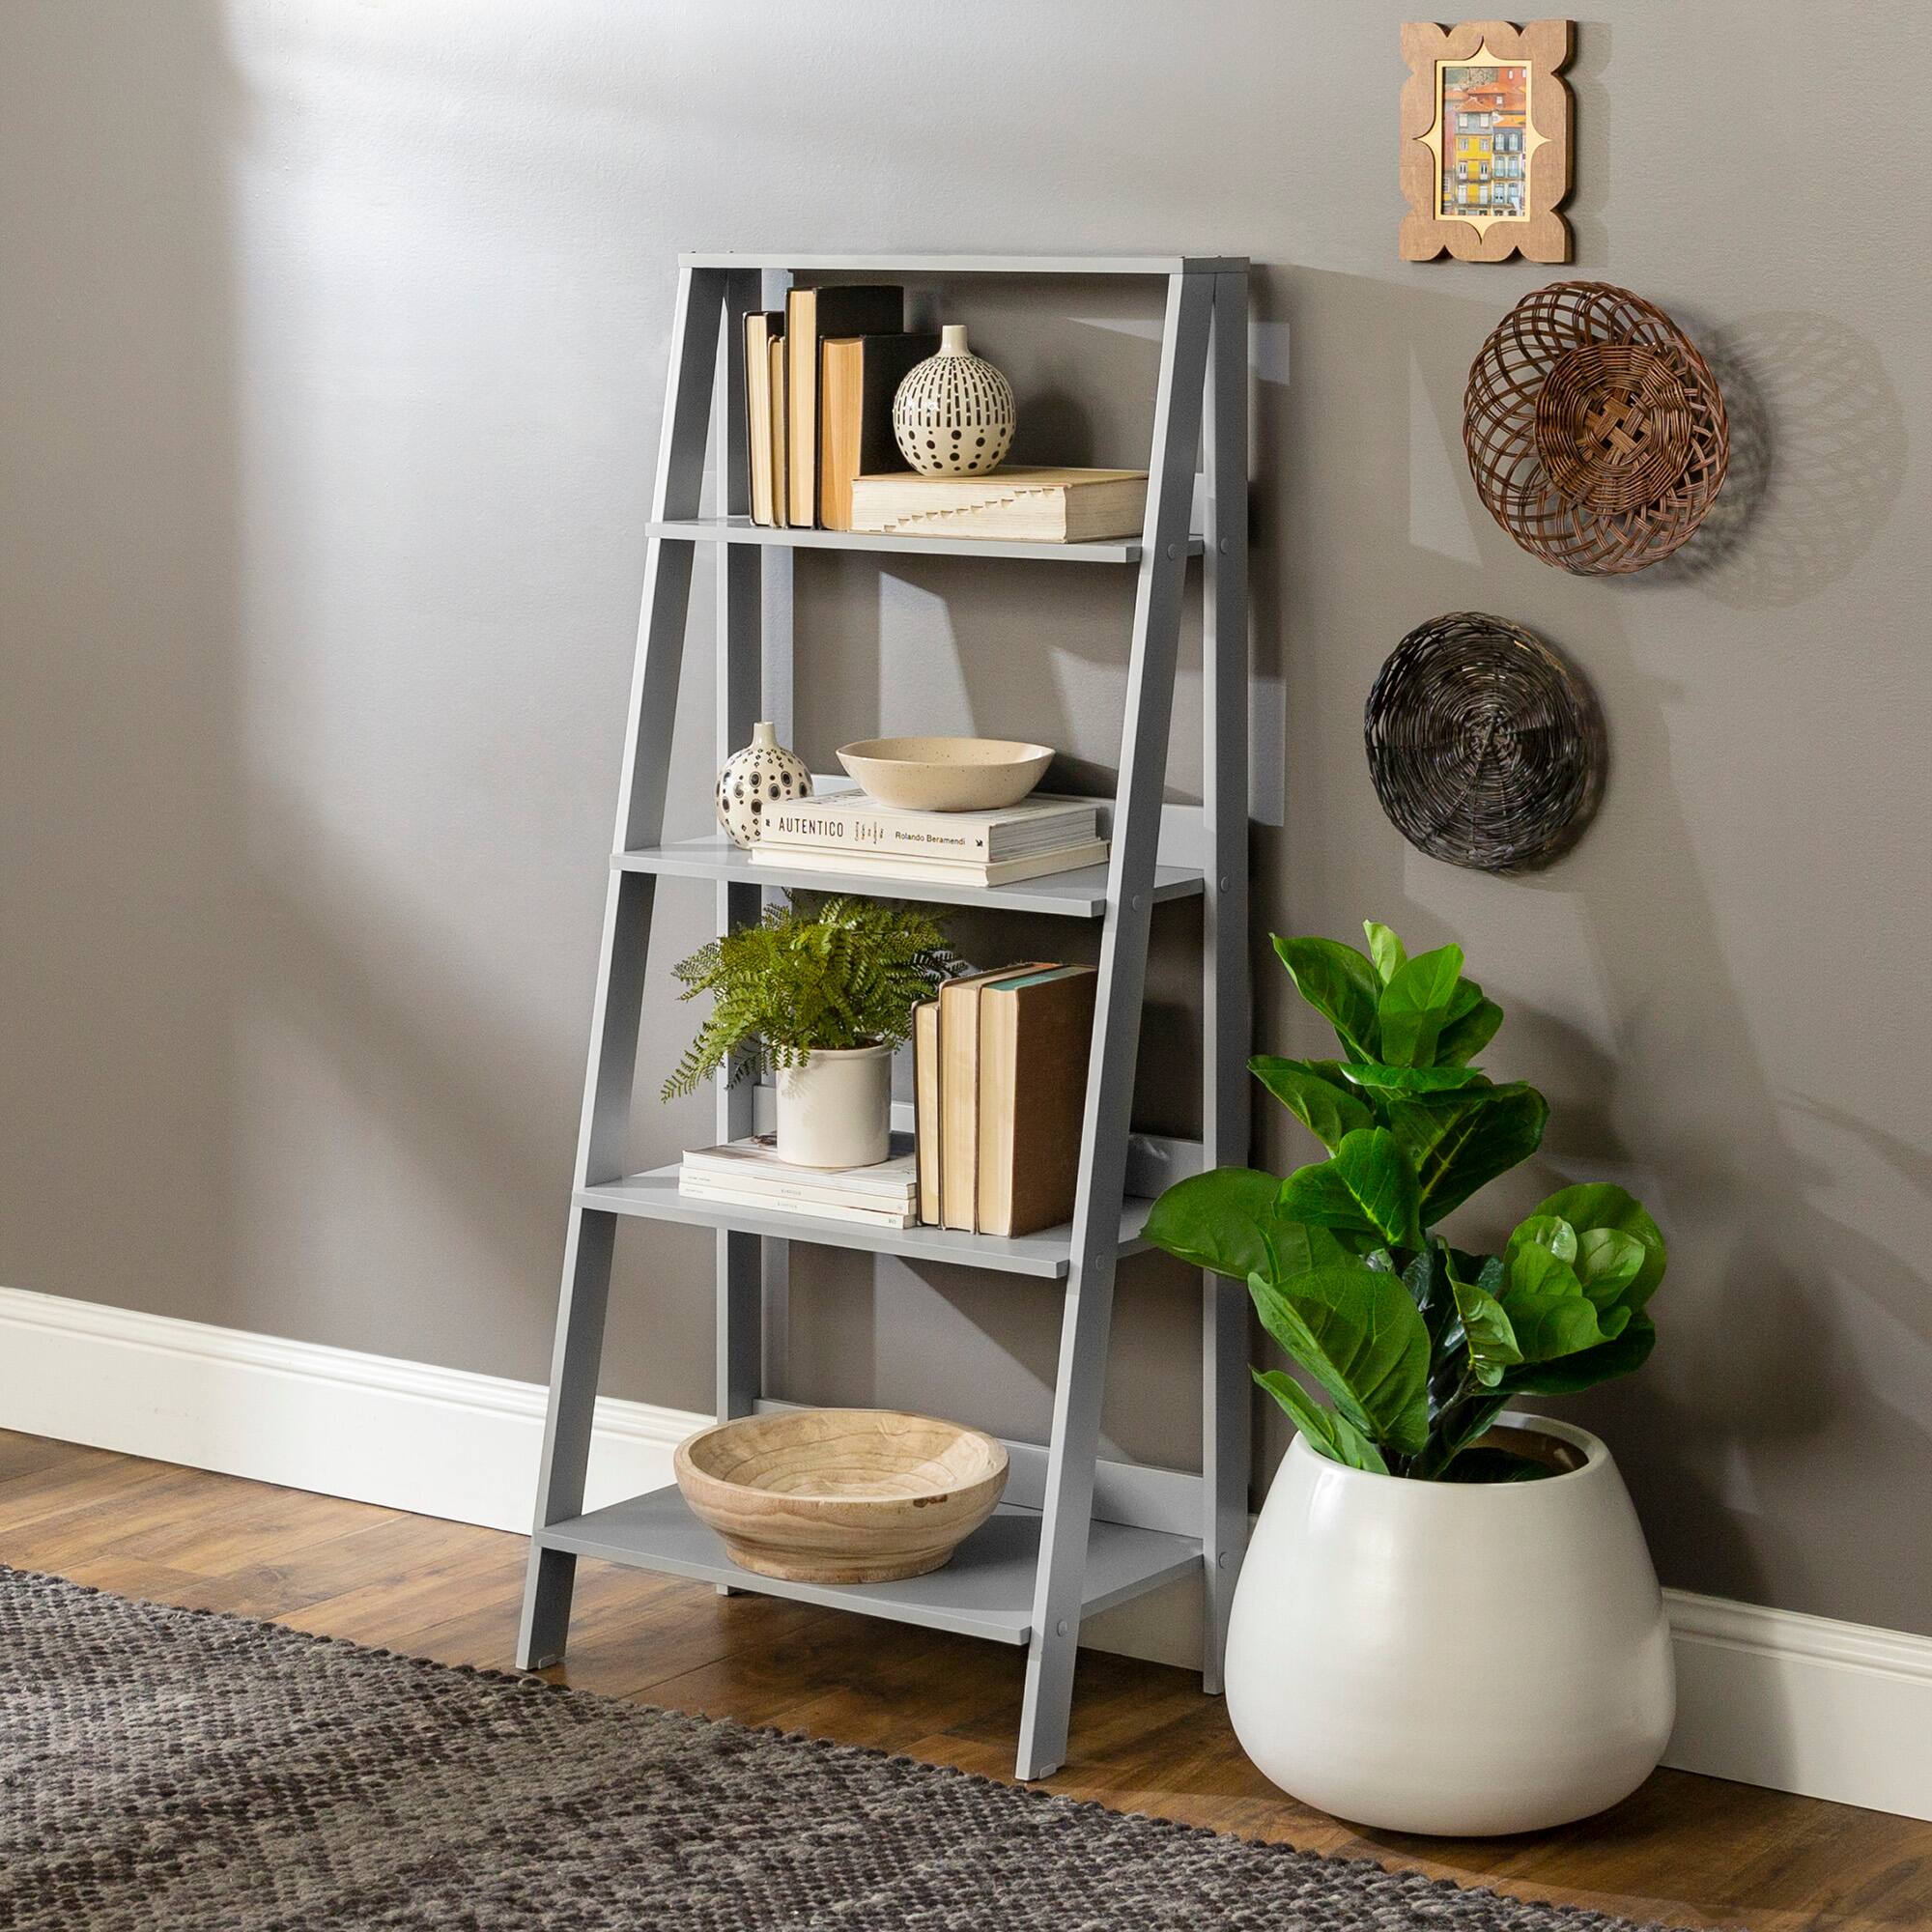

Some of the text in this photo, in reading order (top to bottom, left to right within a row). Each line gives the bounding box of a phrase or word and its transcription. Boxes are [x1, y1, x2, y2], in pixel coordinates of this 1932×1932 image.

[779, 817, 843, 838] AUTENTICO
[895, 831, 924, 842] Rolando
[926, 834, 965, 845] Beramendi
